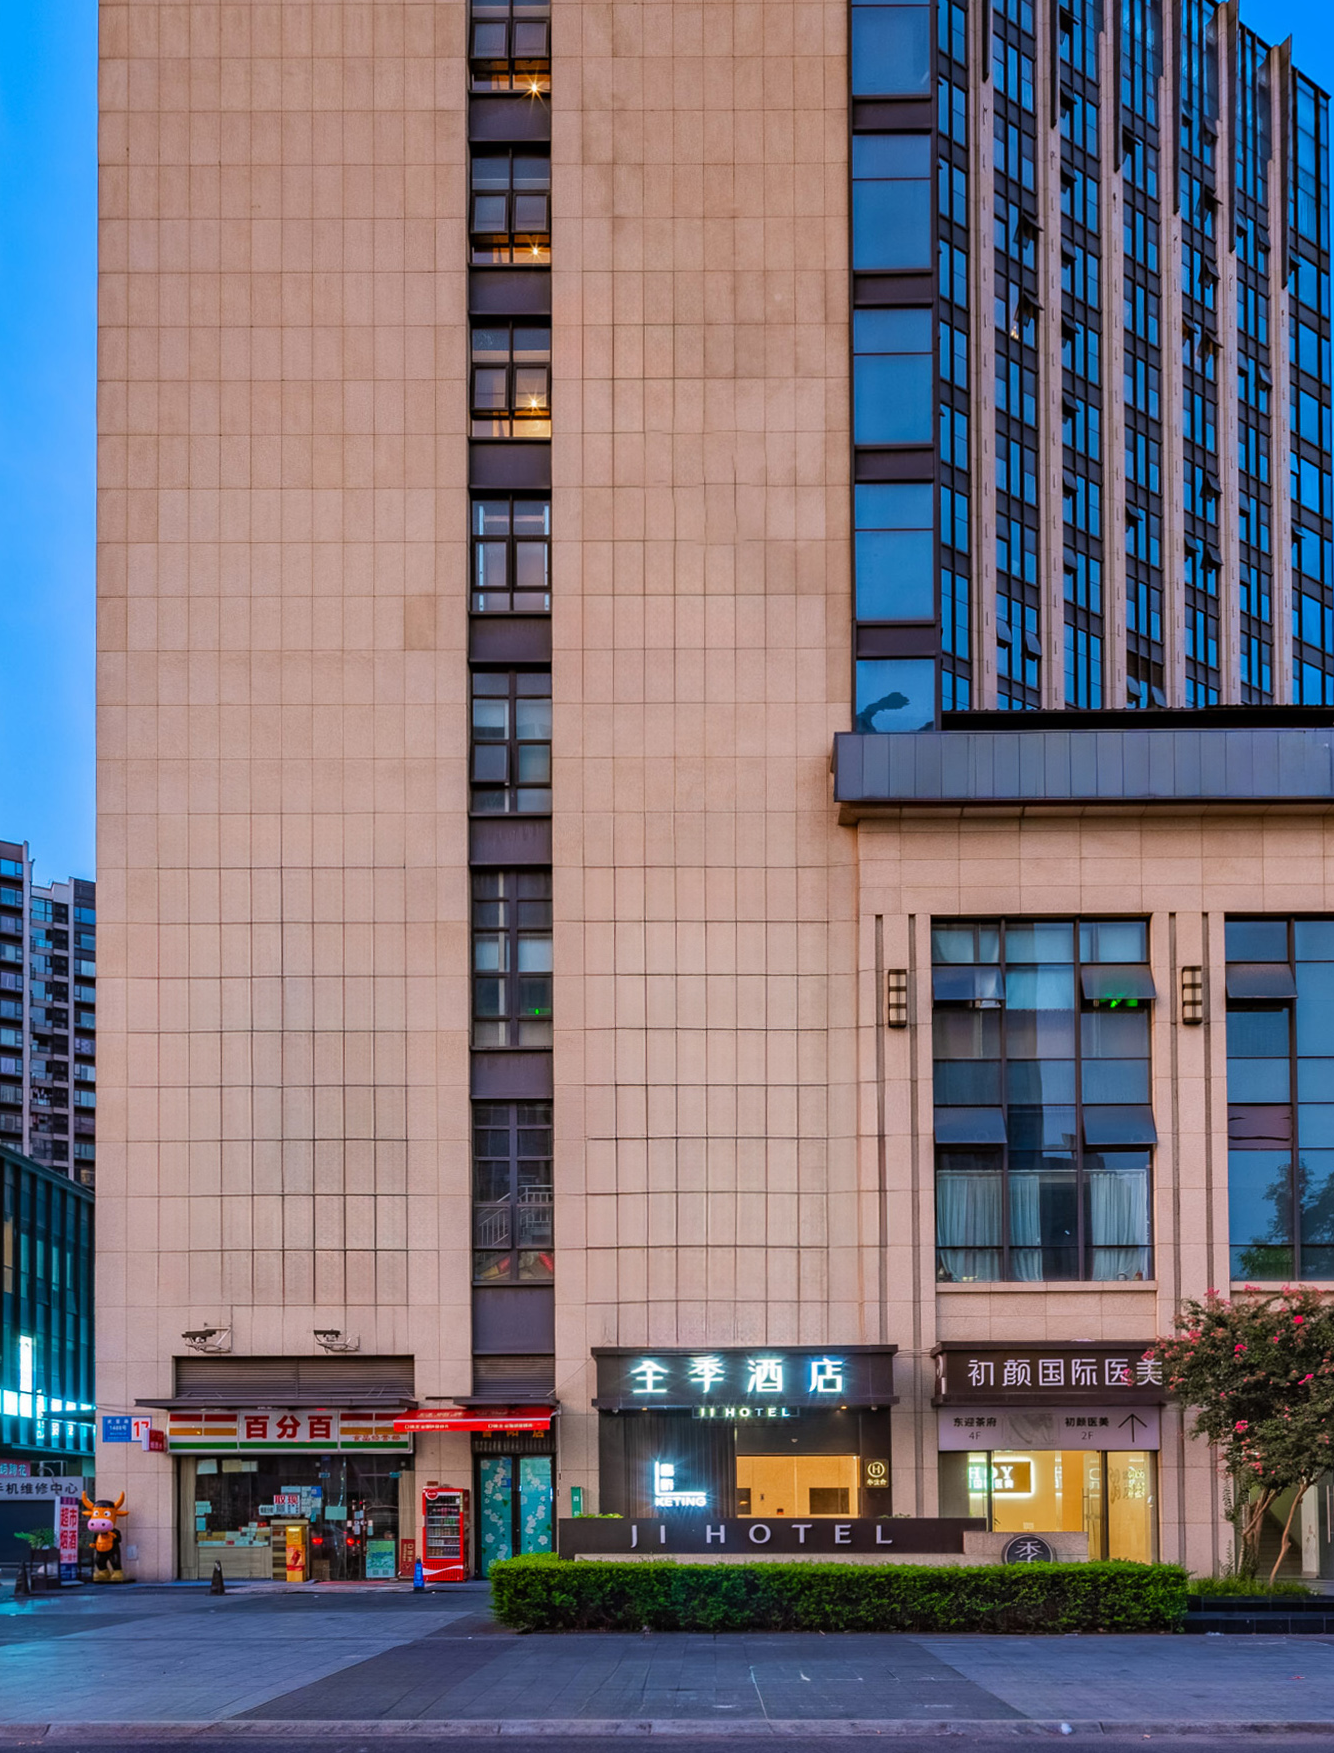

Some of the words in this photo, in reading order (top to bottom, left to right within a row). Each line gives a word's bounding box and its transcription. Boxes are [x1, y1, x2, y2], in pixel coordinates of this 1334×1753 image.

[630, 1355, 844, 1394] 全季酒店
[968, 1358, 1163, 1387] 初颜国际医美
[725, 1407, 791, 1418] HOTEL
[244, 1415, 333, 1440] 百分百
[1065, 1417, 1109, 1427] 初颜医美
[969, 1432, 981, 1440] 4F
[1081, 1431, 1094, 1440] 2F
[655, 1496, 707, 1507] KETING
[630, 1524, 666, 1548] JI
[706, 1523, 893, 1545] HOTEL
